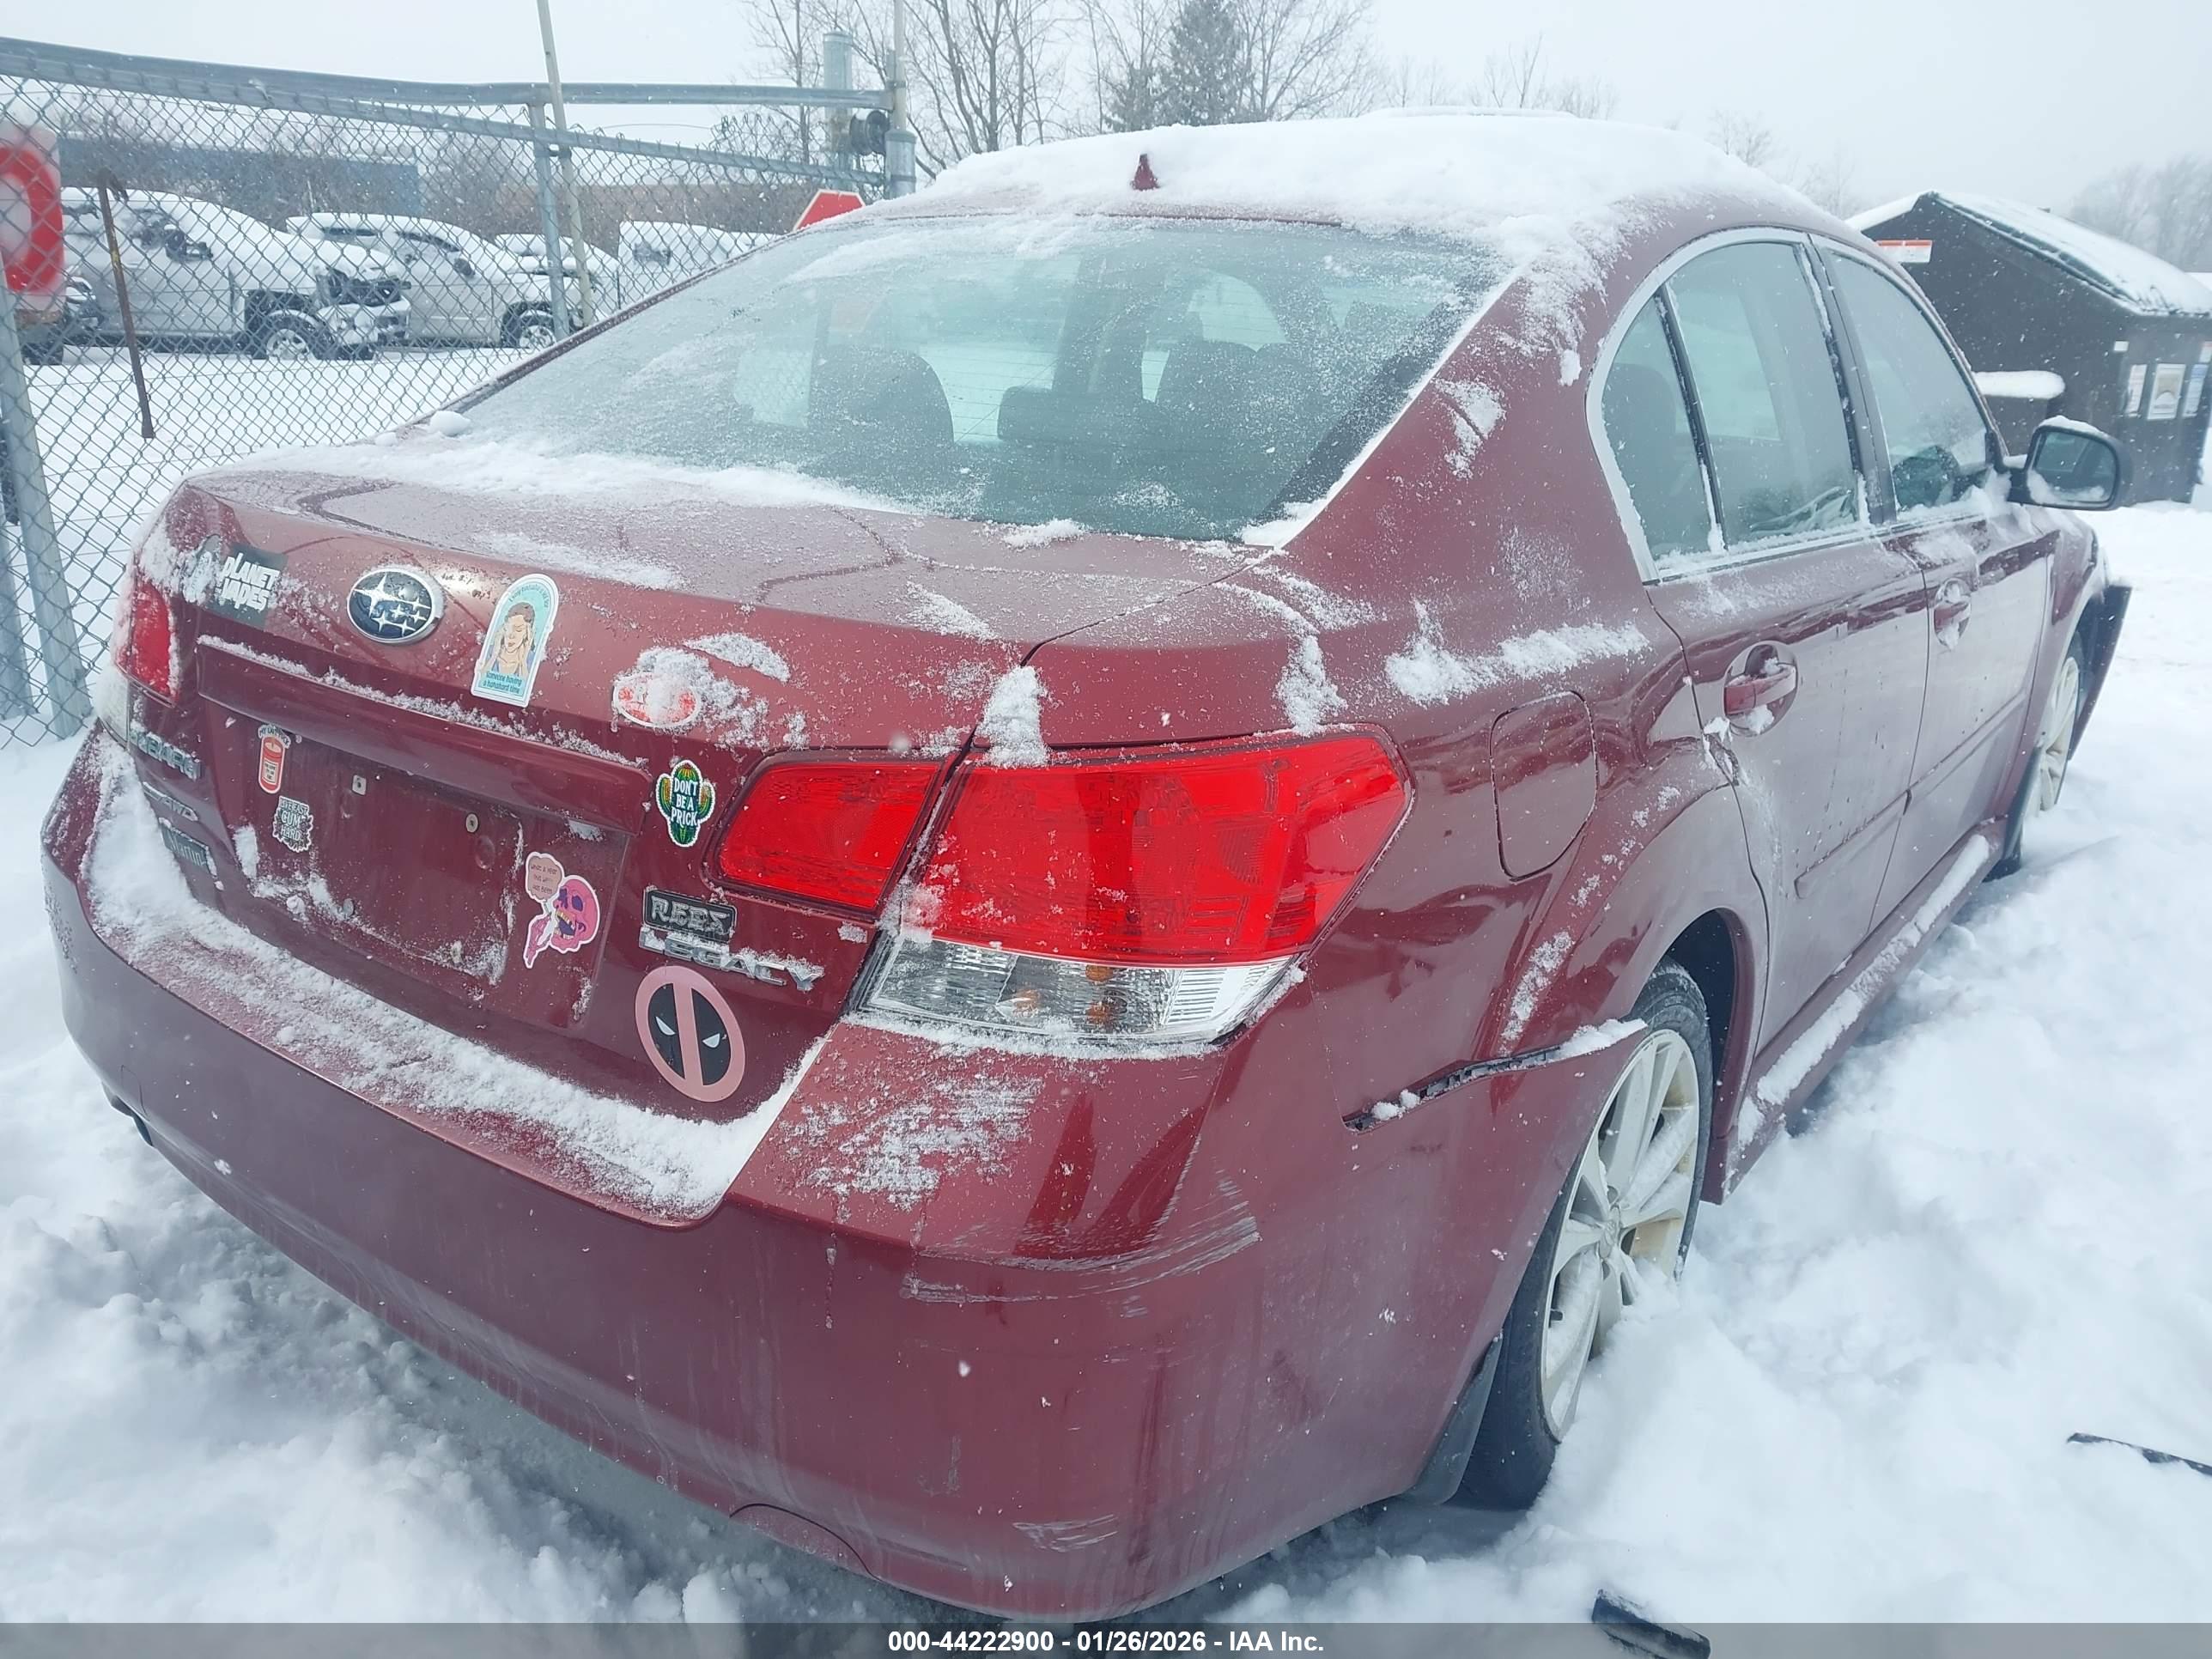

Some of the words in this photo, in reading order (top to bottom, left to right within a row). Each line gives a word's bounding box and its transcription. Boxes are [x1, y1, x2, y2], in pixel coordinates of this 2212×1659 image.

[223, 552, 280, 590] PLANET
[221, 576, 271, 612] VAPES
[674, 777, 699, 797] DON'T
[676, 793, 687, 810] BE
[686, 795, 695, 811] A
[281, 810, 301, 830] CUM
[670, 805, 698, 828] PRICK
[280, 823, 301, 842] HARD
[639, 927, 825, 992] LEGACY
